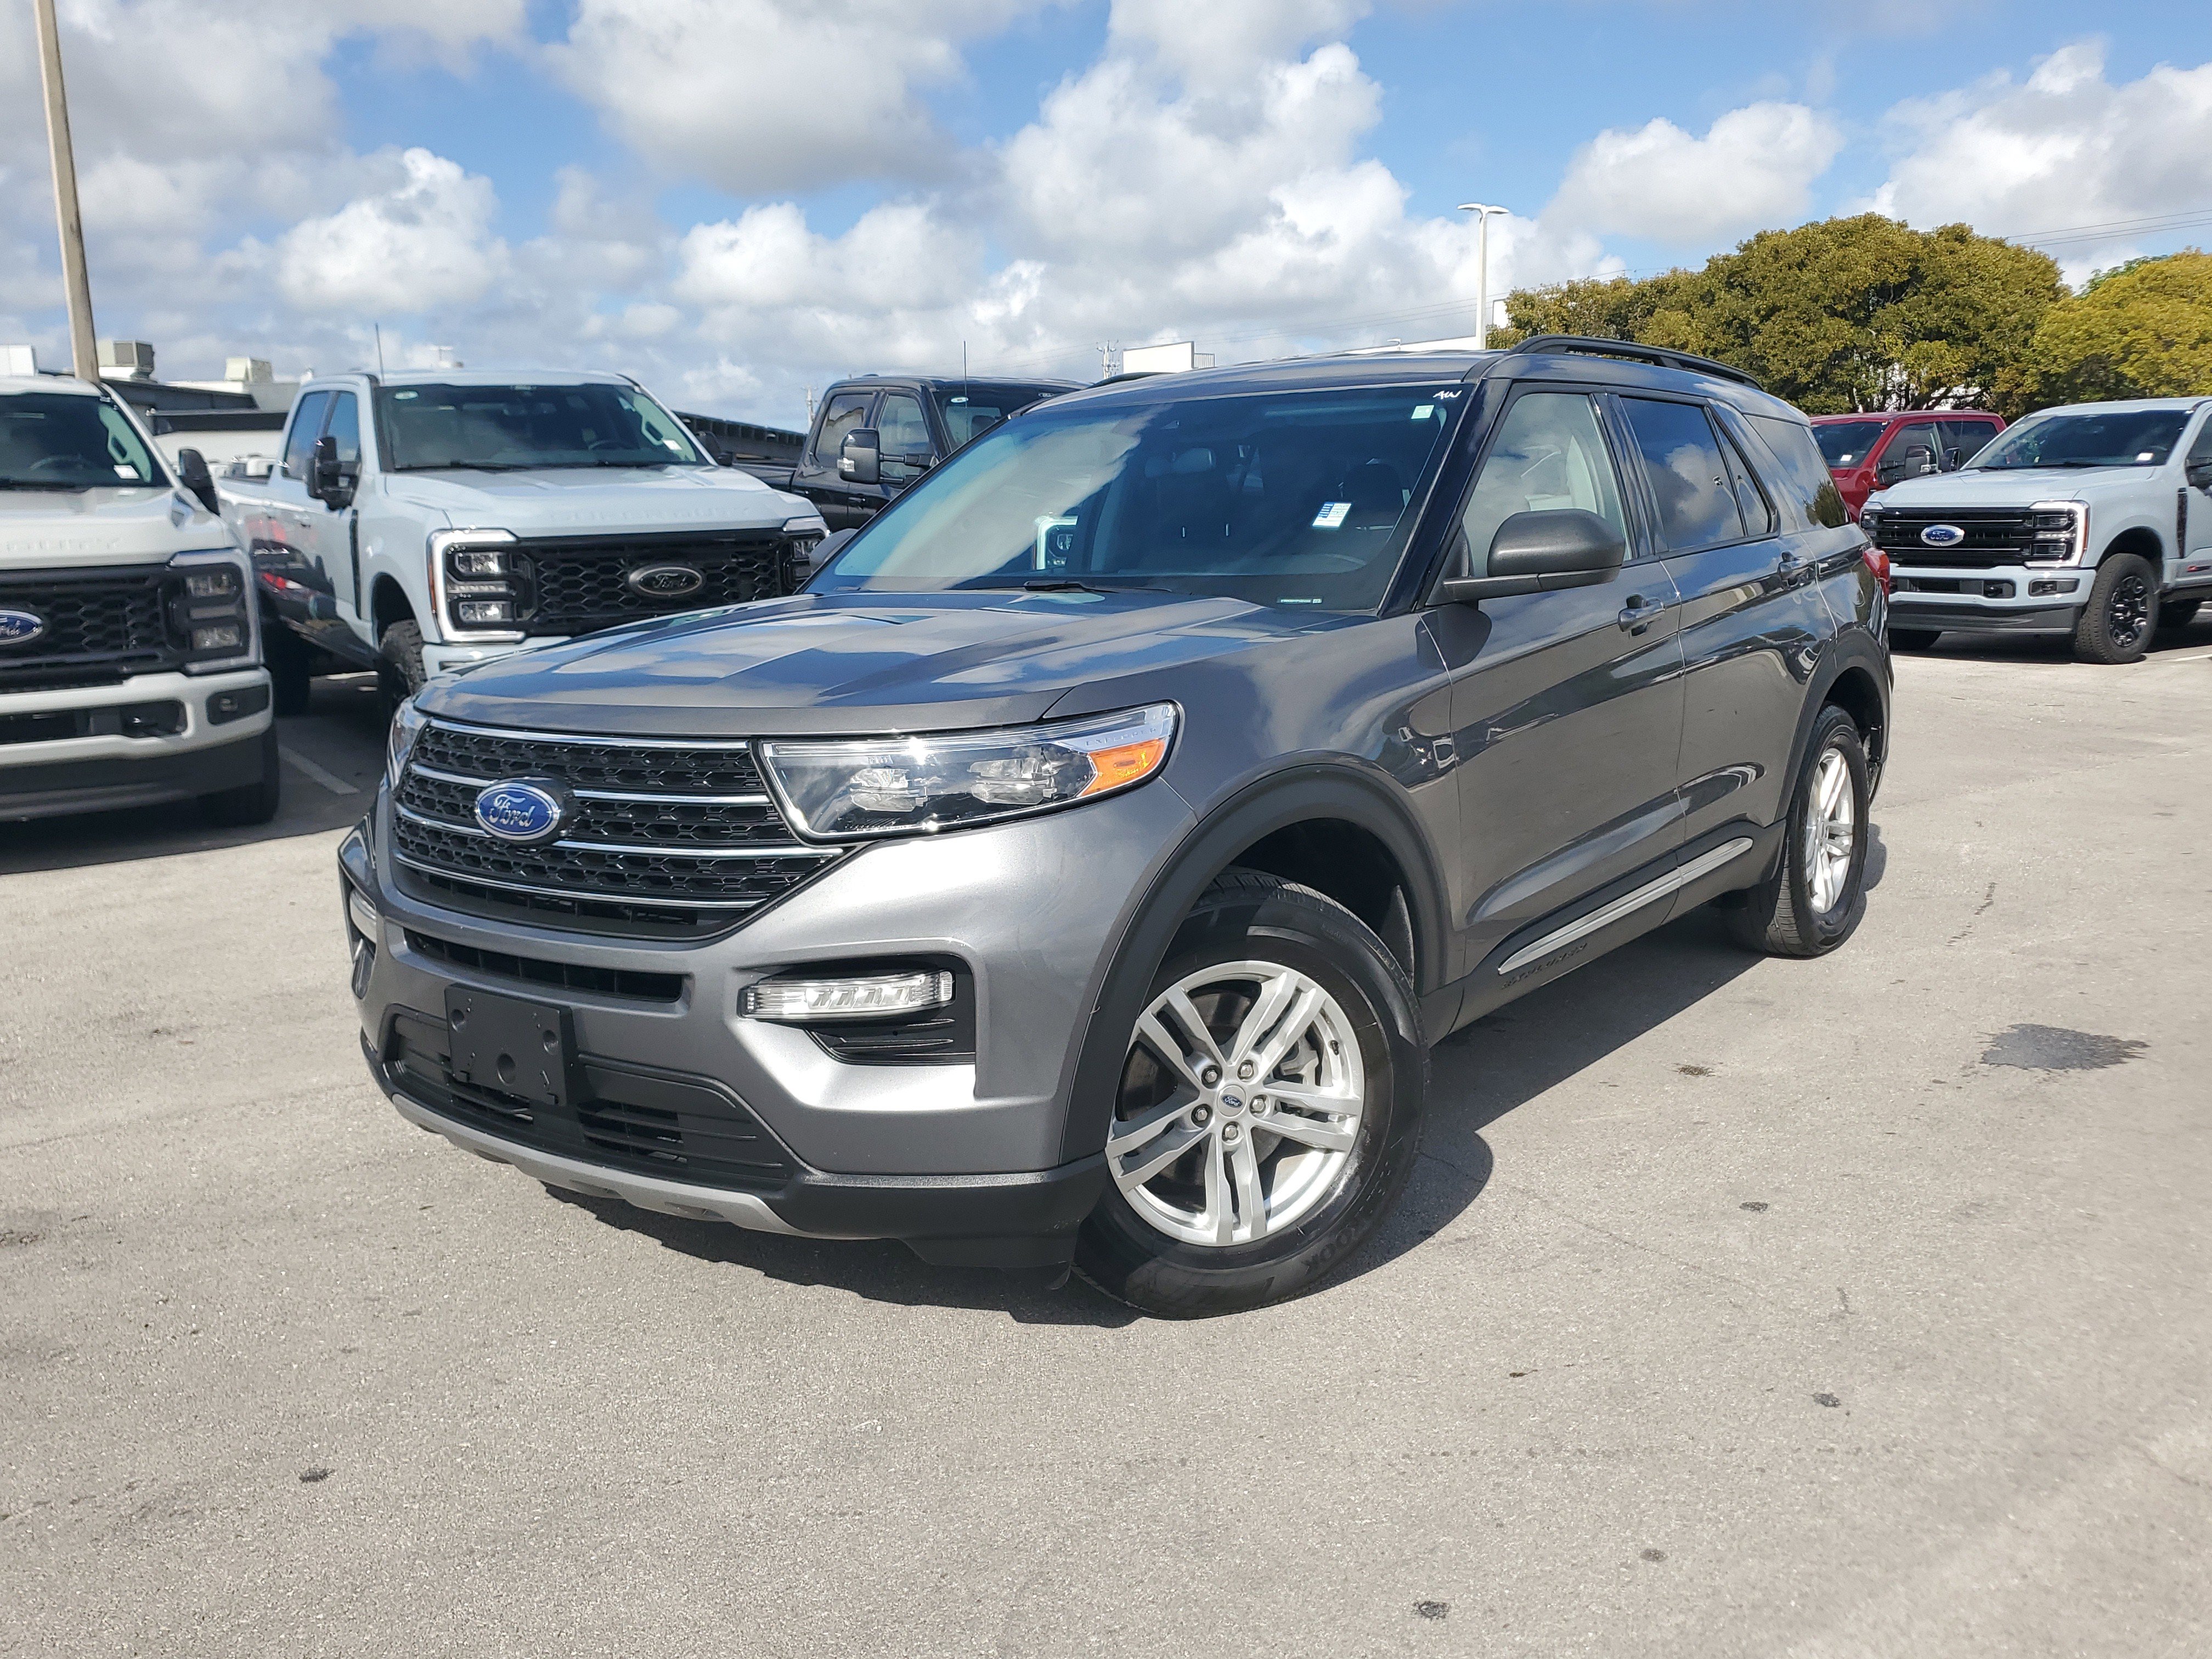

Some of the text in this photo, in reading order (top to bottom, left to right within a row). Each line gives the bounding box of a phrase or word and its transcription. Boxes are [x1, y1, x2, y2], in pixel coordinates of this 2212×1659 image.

[1085, 727, 1156, 747] EXPLORER
[489, 794, 536, 827] Ford
[1224, 1096, 1240, 1106] Ford
